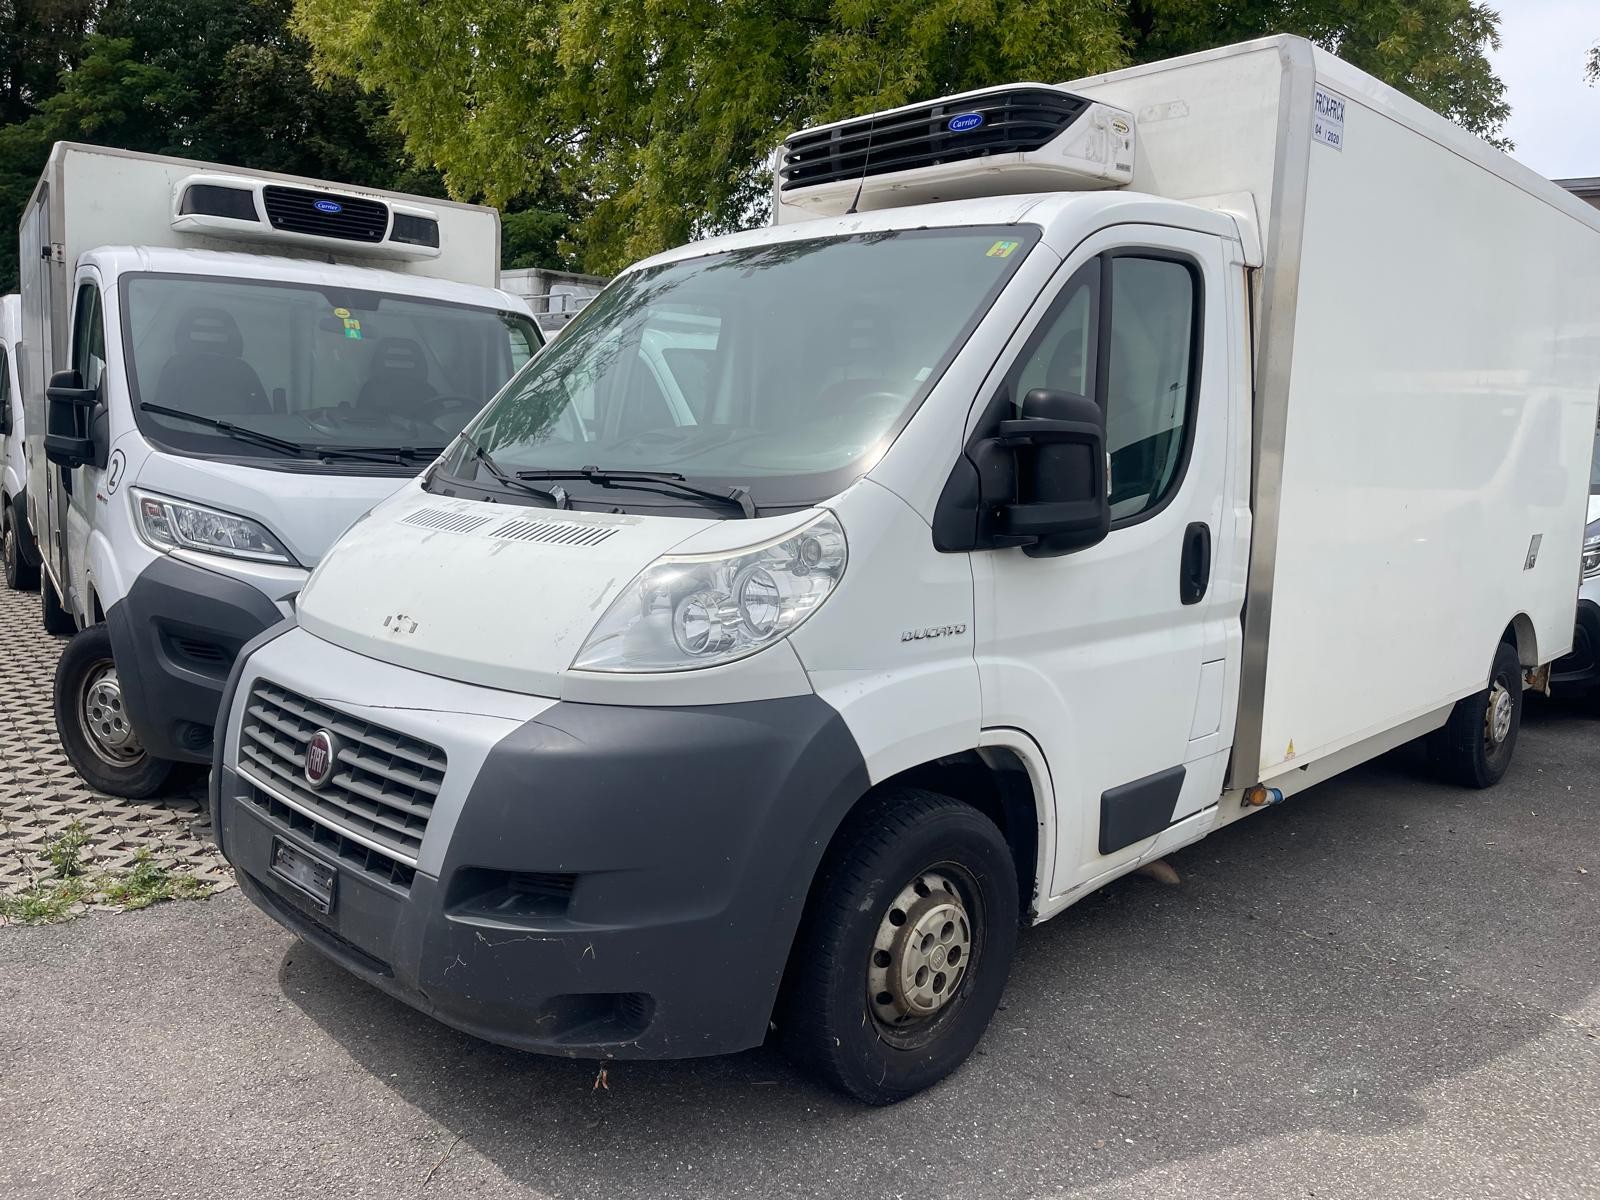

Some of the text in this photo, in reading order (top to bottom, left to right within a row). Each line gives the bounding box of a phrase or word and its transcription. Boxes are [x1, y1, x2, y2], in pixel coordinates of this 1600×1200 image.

[952, 118, 978, 129] Carrier
[109, 458, 119, 487] 2
[900, 624, 966, 642] DUCATO
[310, 745, 327, 774] FIAT
